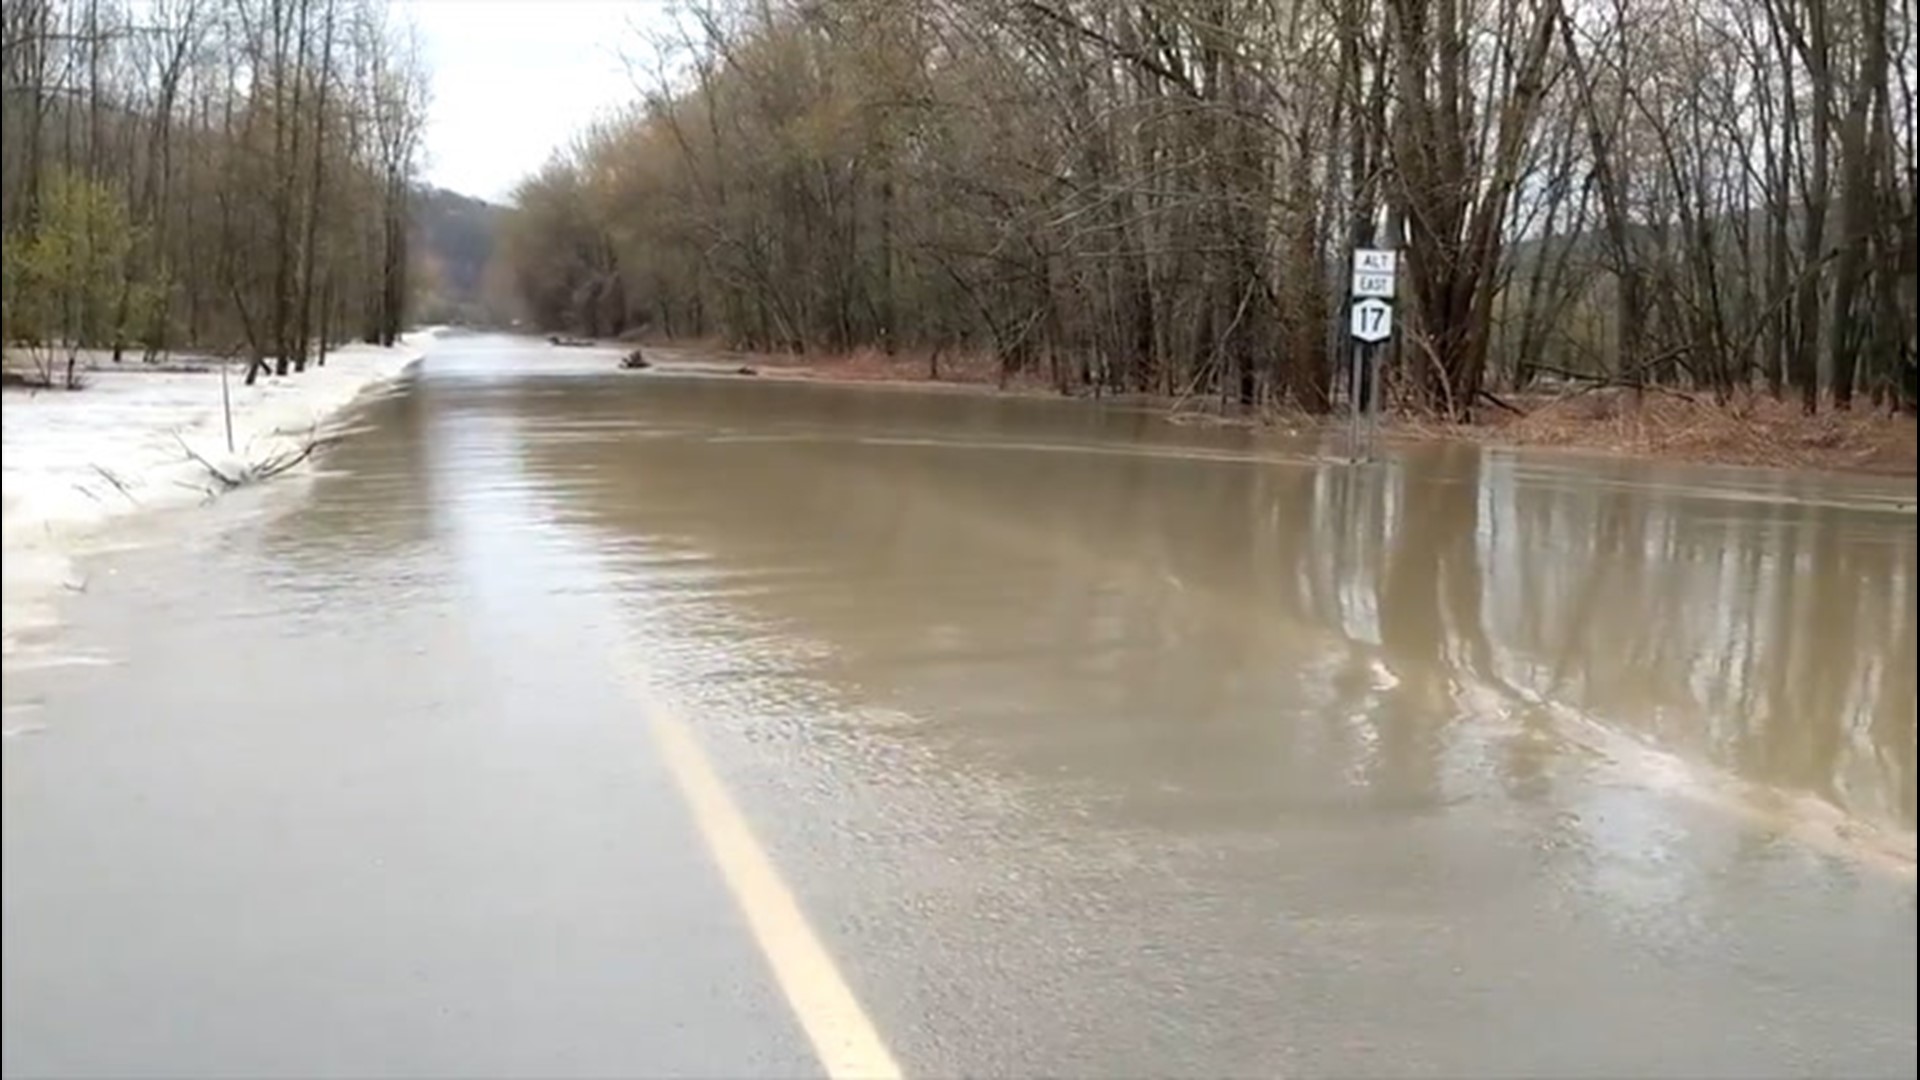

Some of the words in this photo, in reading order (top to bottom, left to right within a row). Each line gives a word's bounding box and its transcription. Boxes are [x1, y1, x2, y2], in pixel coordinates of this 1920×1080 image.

[1363, 254, 1388, 268] ALT
[1360, 277, 1387, 292] EAST
[1361, 306, 1385, 332] 17
